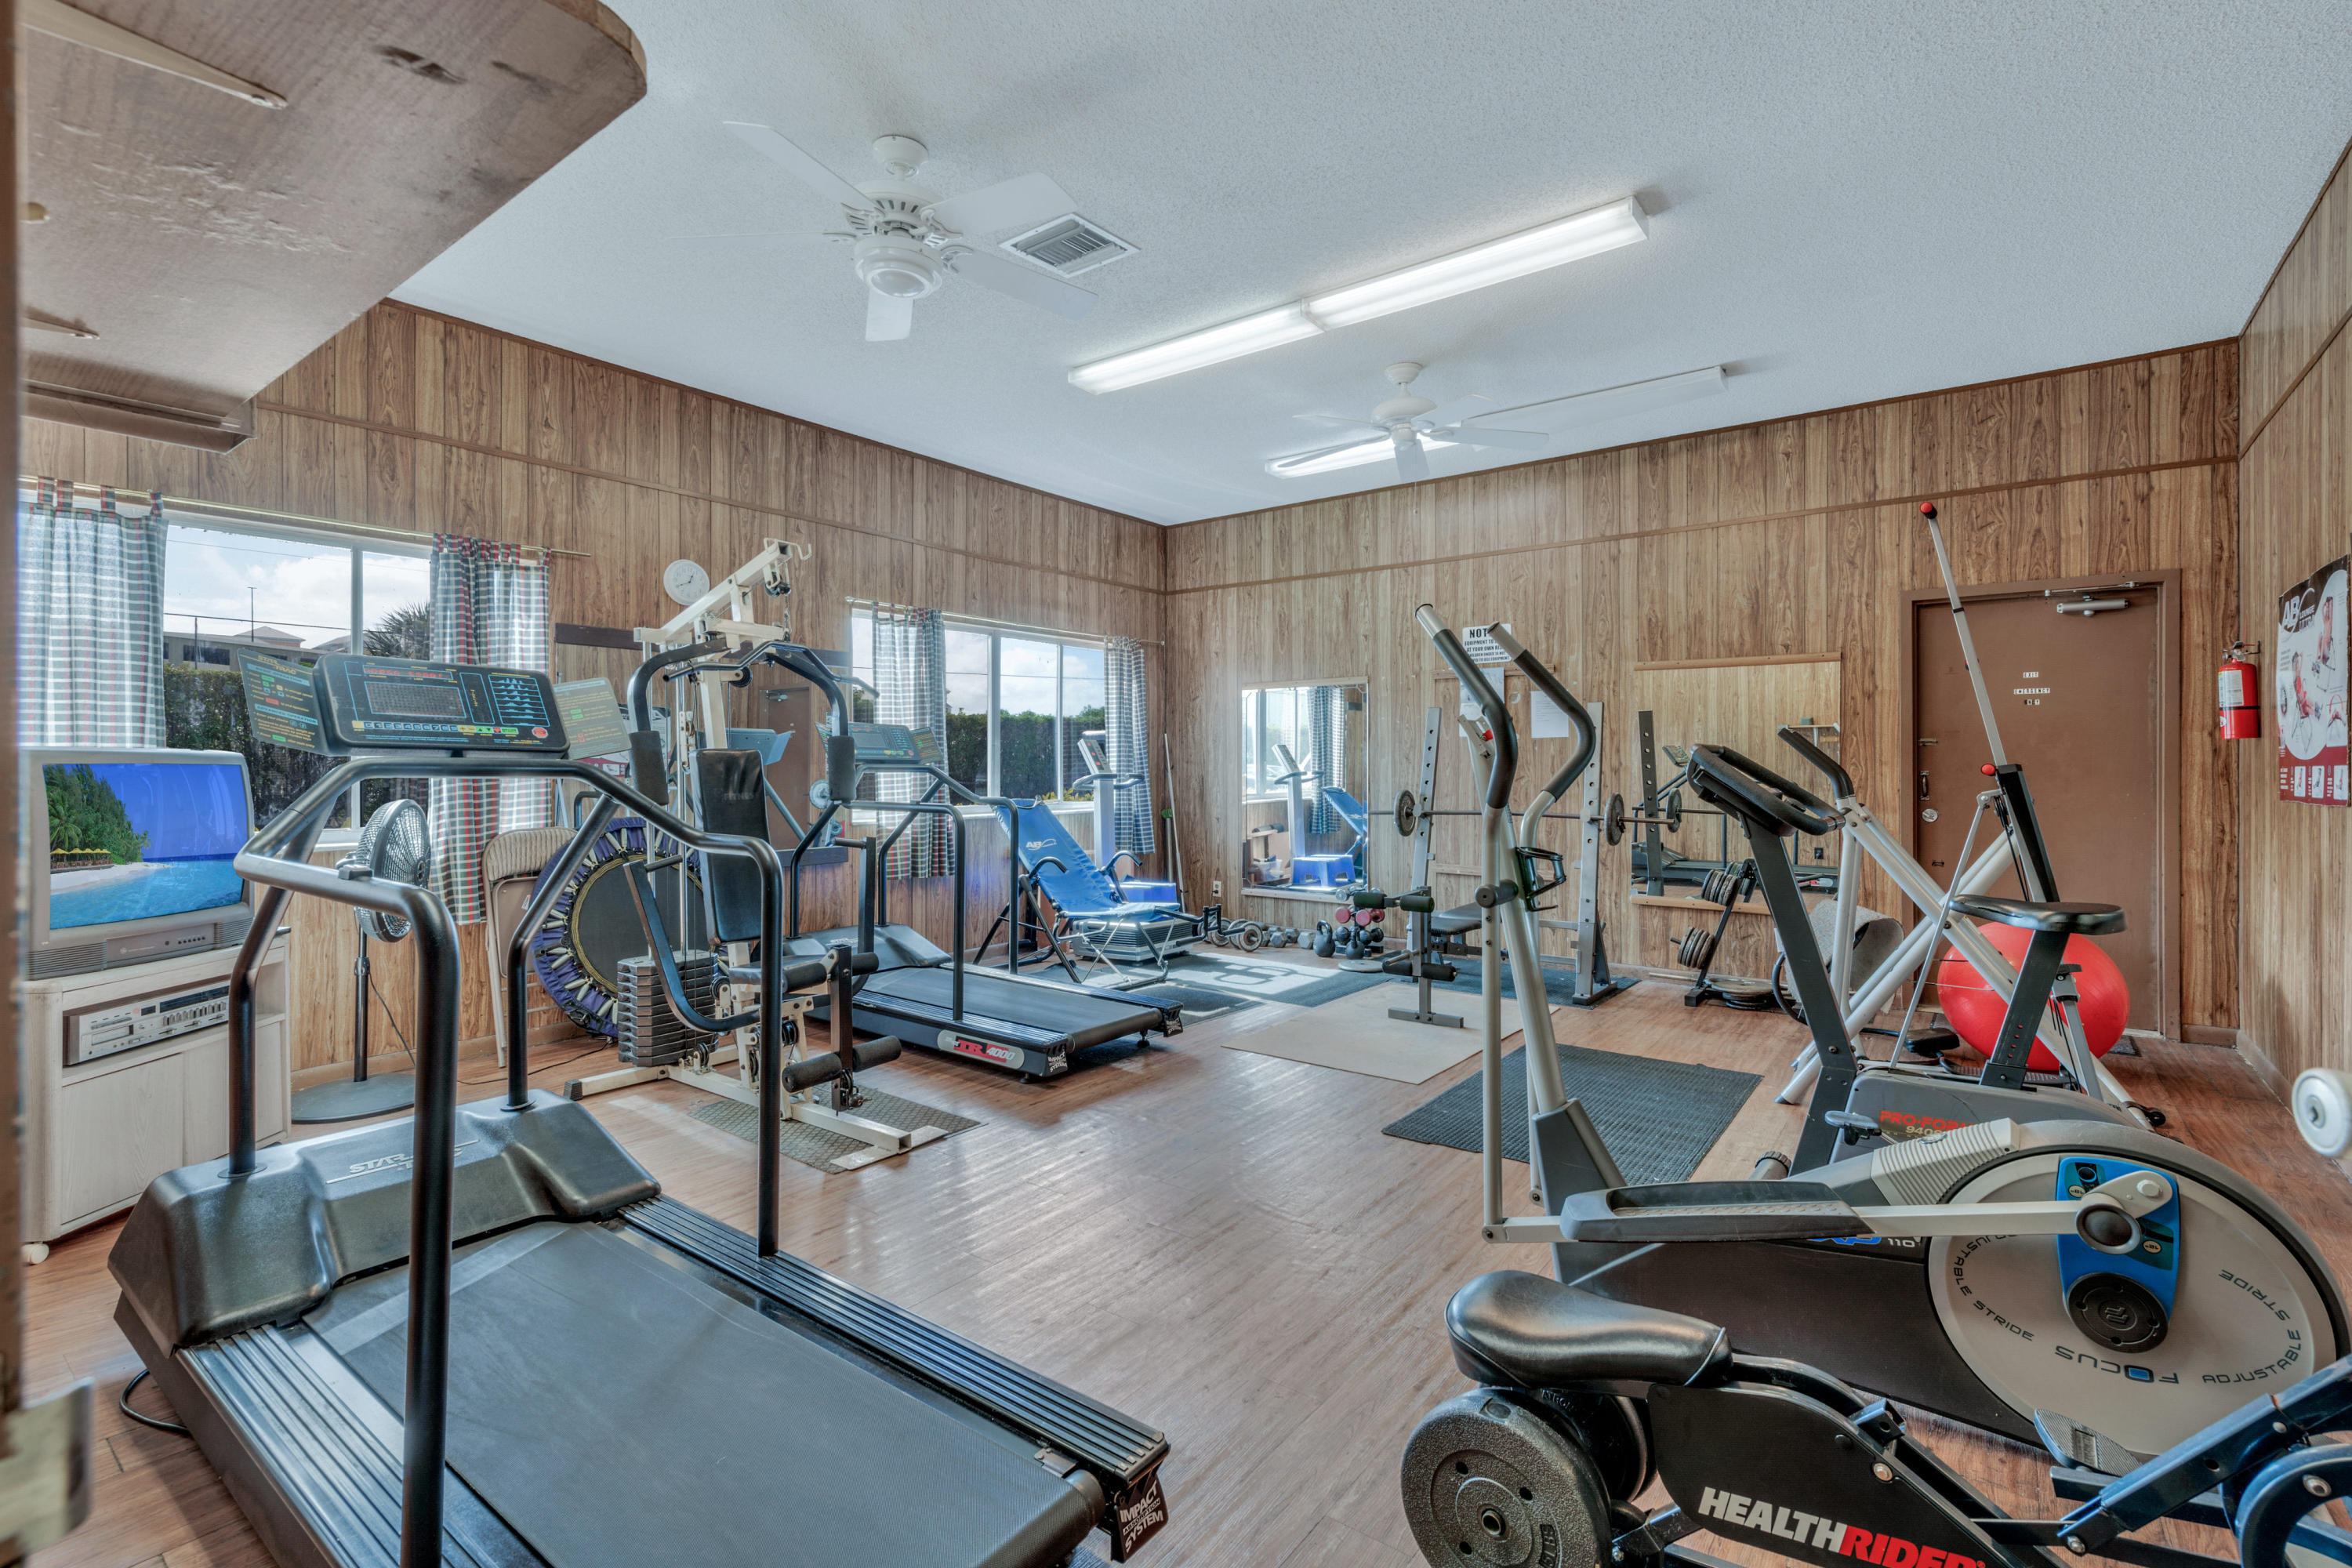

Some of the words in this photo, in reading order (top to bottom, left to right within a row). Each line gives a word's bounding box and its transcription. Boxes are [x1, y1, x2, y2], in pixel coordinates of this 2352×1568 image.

[2281, 596, 2300, 630] AB
[986, 1047, 1016, 1061] 4000
[2219, 1269, 2291, 1322] STRIDE
[1973, 1300, 2035, 1341] STRIDE
[2055, 1345, 2180, 1385] FOCUS
[2202, 1329, 2302, 1384] ADJUSTABLE
[1120, 1479, 1158, 1523] IMPACT
[1123, 1497, 1161, 1536] ABSORPTION
[1125, 1510, 1164, 1554] SYSTEM
